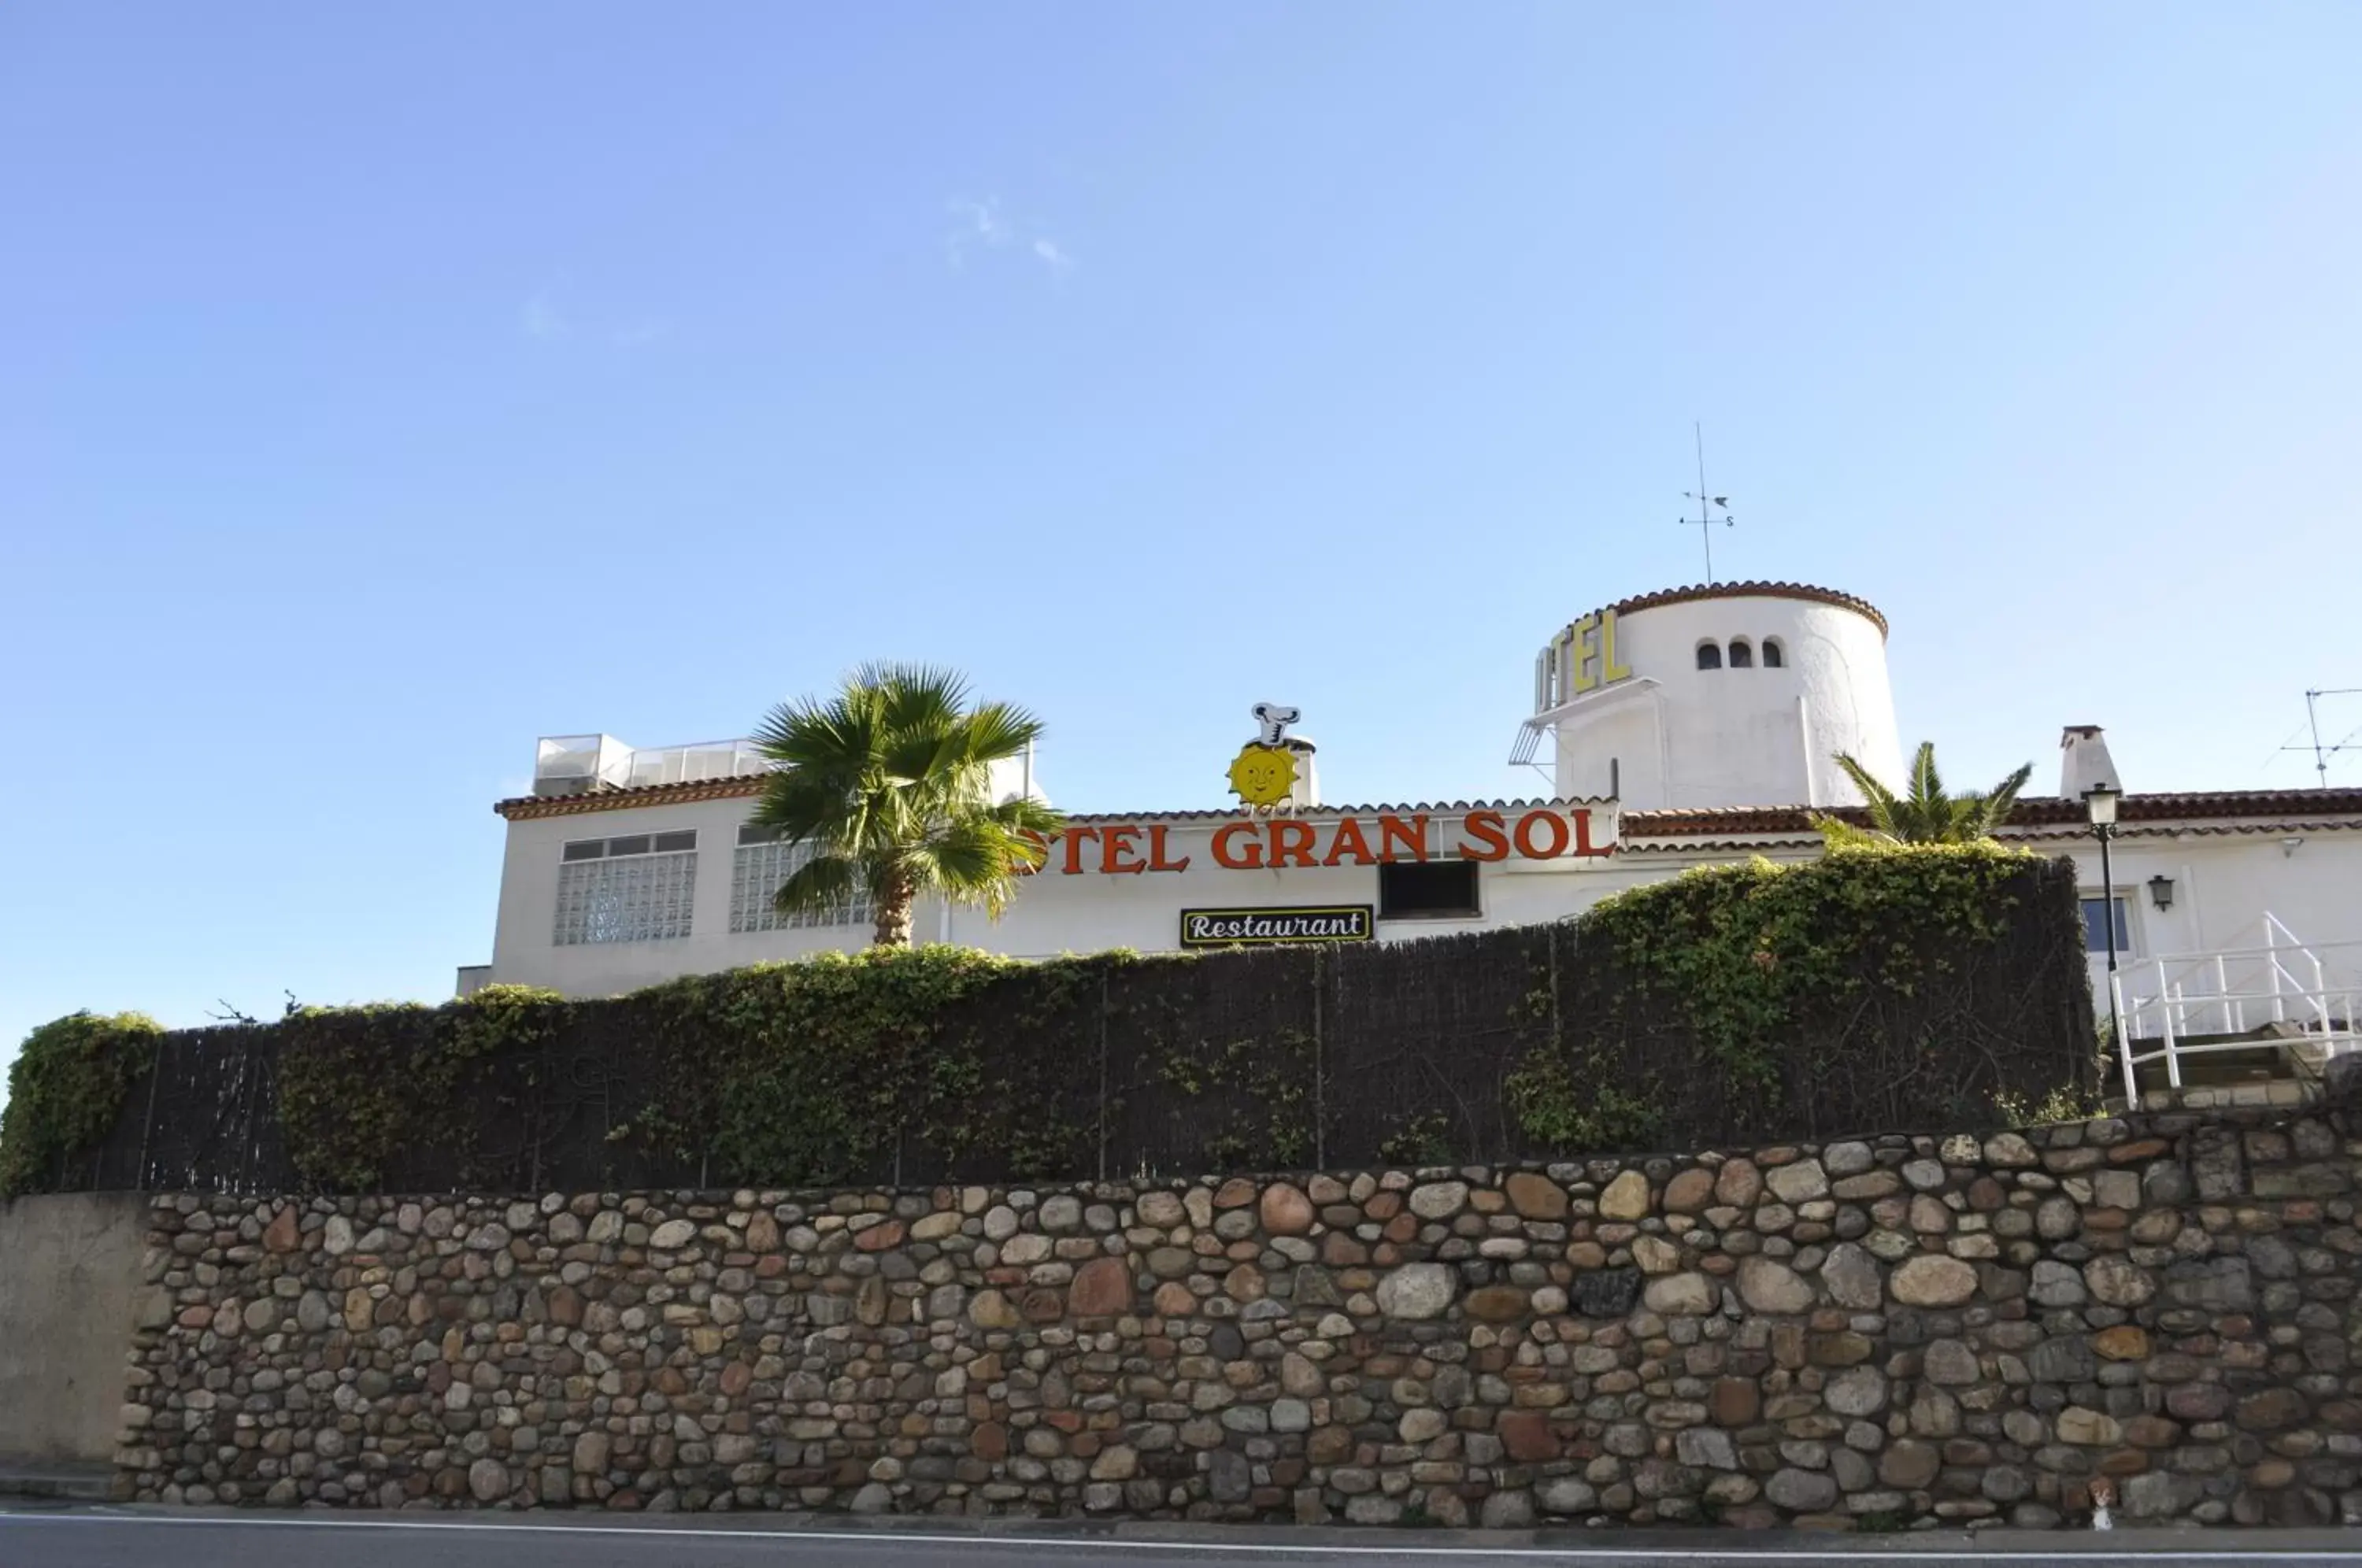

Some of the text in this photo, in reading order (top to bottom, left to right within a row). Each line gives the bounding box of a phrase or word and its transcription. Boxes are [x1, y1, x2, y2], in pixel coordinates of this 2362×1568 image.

[1211, 815, 1429, 869] GRAN
[1457, 808, 1616, 862] SOL
[1190, 913, 1361, 938] Restaurant
